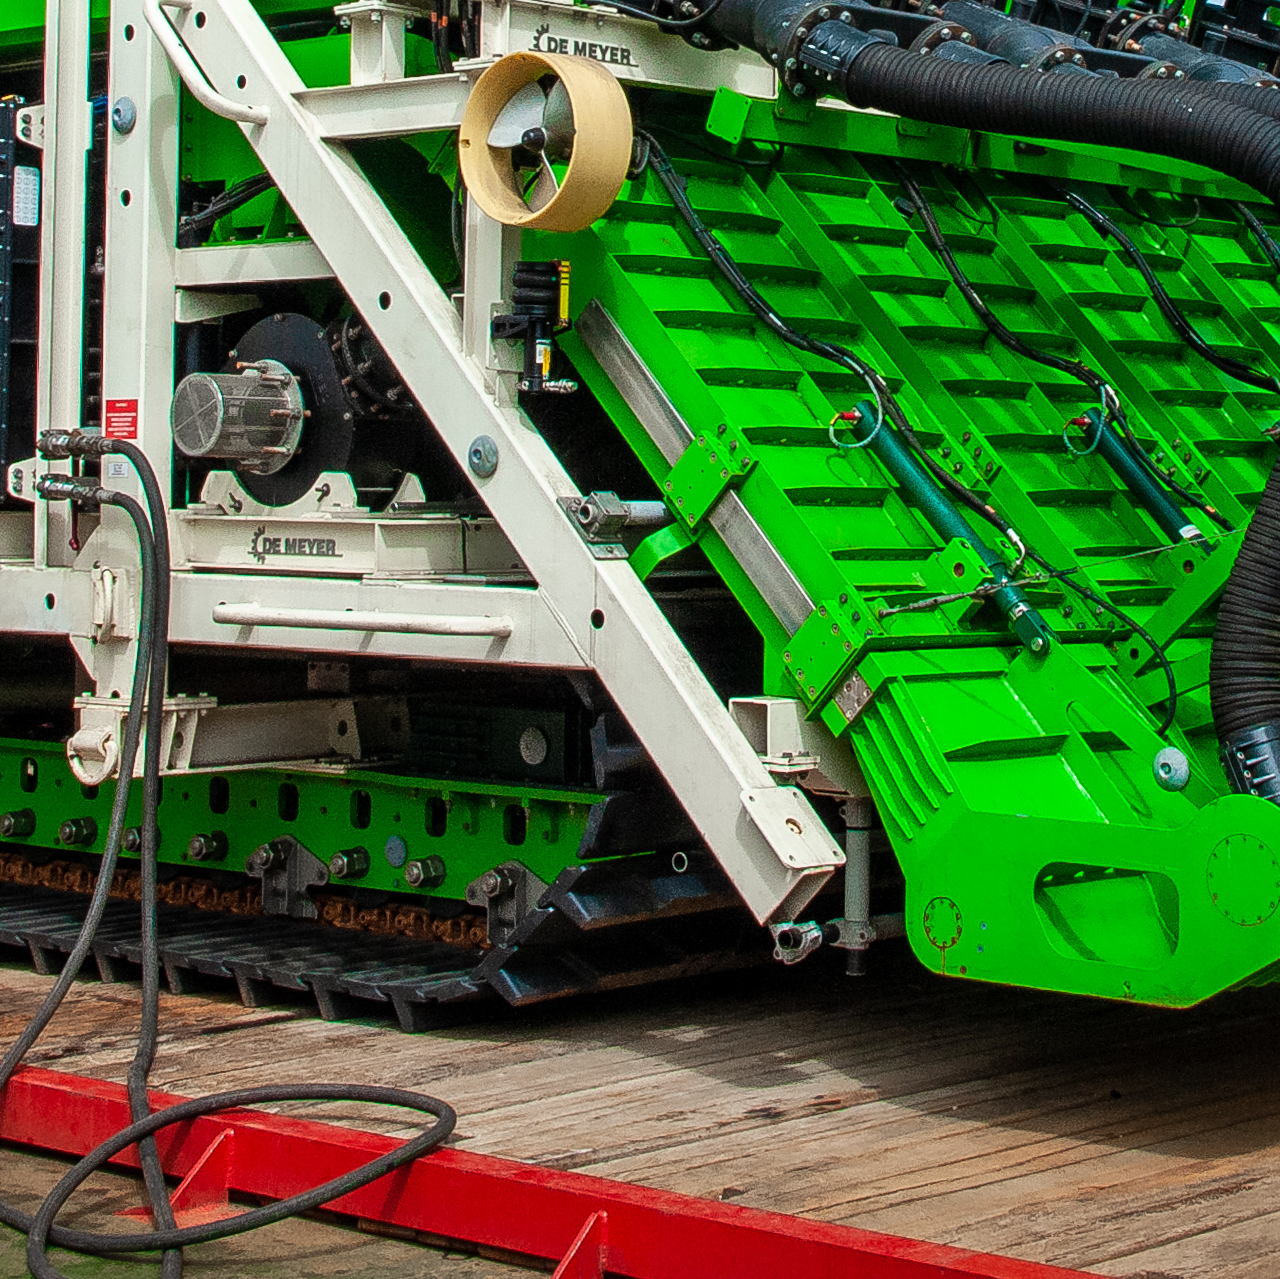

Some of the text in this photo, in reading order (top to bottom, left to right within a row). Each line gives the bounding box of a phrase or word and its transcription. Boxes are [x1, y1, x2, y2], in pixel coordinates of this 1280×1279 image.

[547, 36, 632, 64] DE MEYER
[262, 537, 337, 555] DE MEYER
